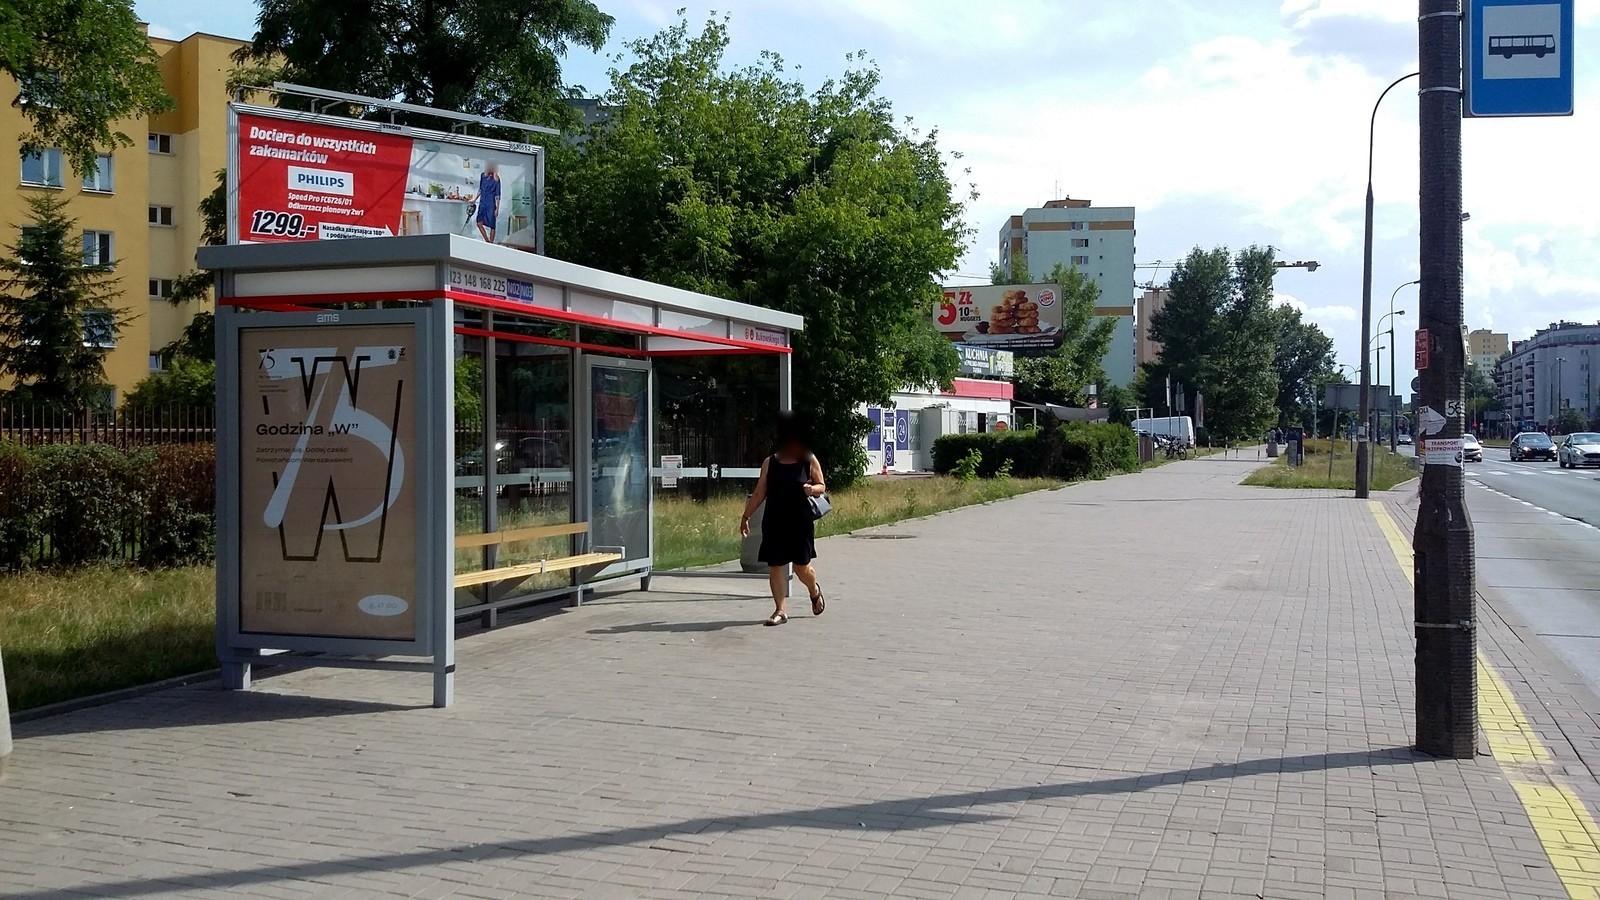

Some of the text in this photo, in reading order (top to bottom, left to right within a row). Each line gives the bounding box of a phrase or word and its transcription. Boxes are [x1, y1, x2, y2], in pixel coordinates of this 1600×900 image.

[250, 126, 377, 154] Dociera do wszystkich
[250, 144, 329, 164] zakamarków
[298, 174, 345, 188] PHILIPS
[288, 192, 308, 202] Speed
[308, 194, 321, 203] Pro
[288, 202, 365, 216] Odkurzacz pionowy 2w1
[464, 274, 477, 287] 148
[479, 277, 492, 290] 168
[493, 279, 506, 293] 225
[937, 292, 957, 325] 5
[316, 313, 340, 323] ams
[965, 347, 989, 362] KUCHNIA
[256, 421, 324, 436] Godzina
